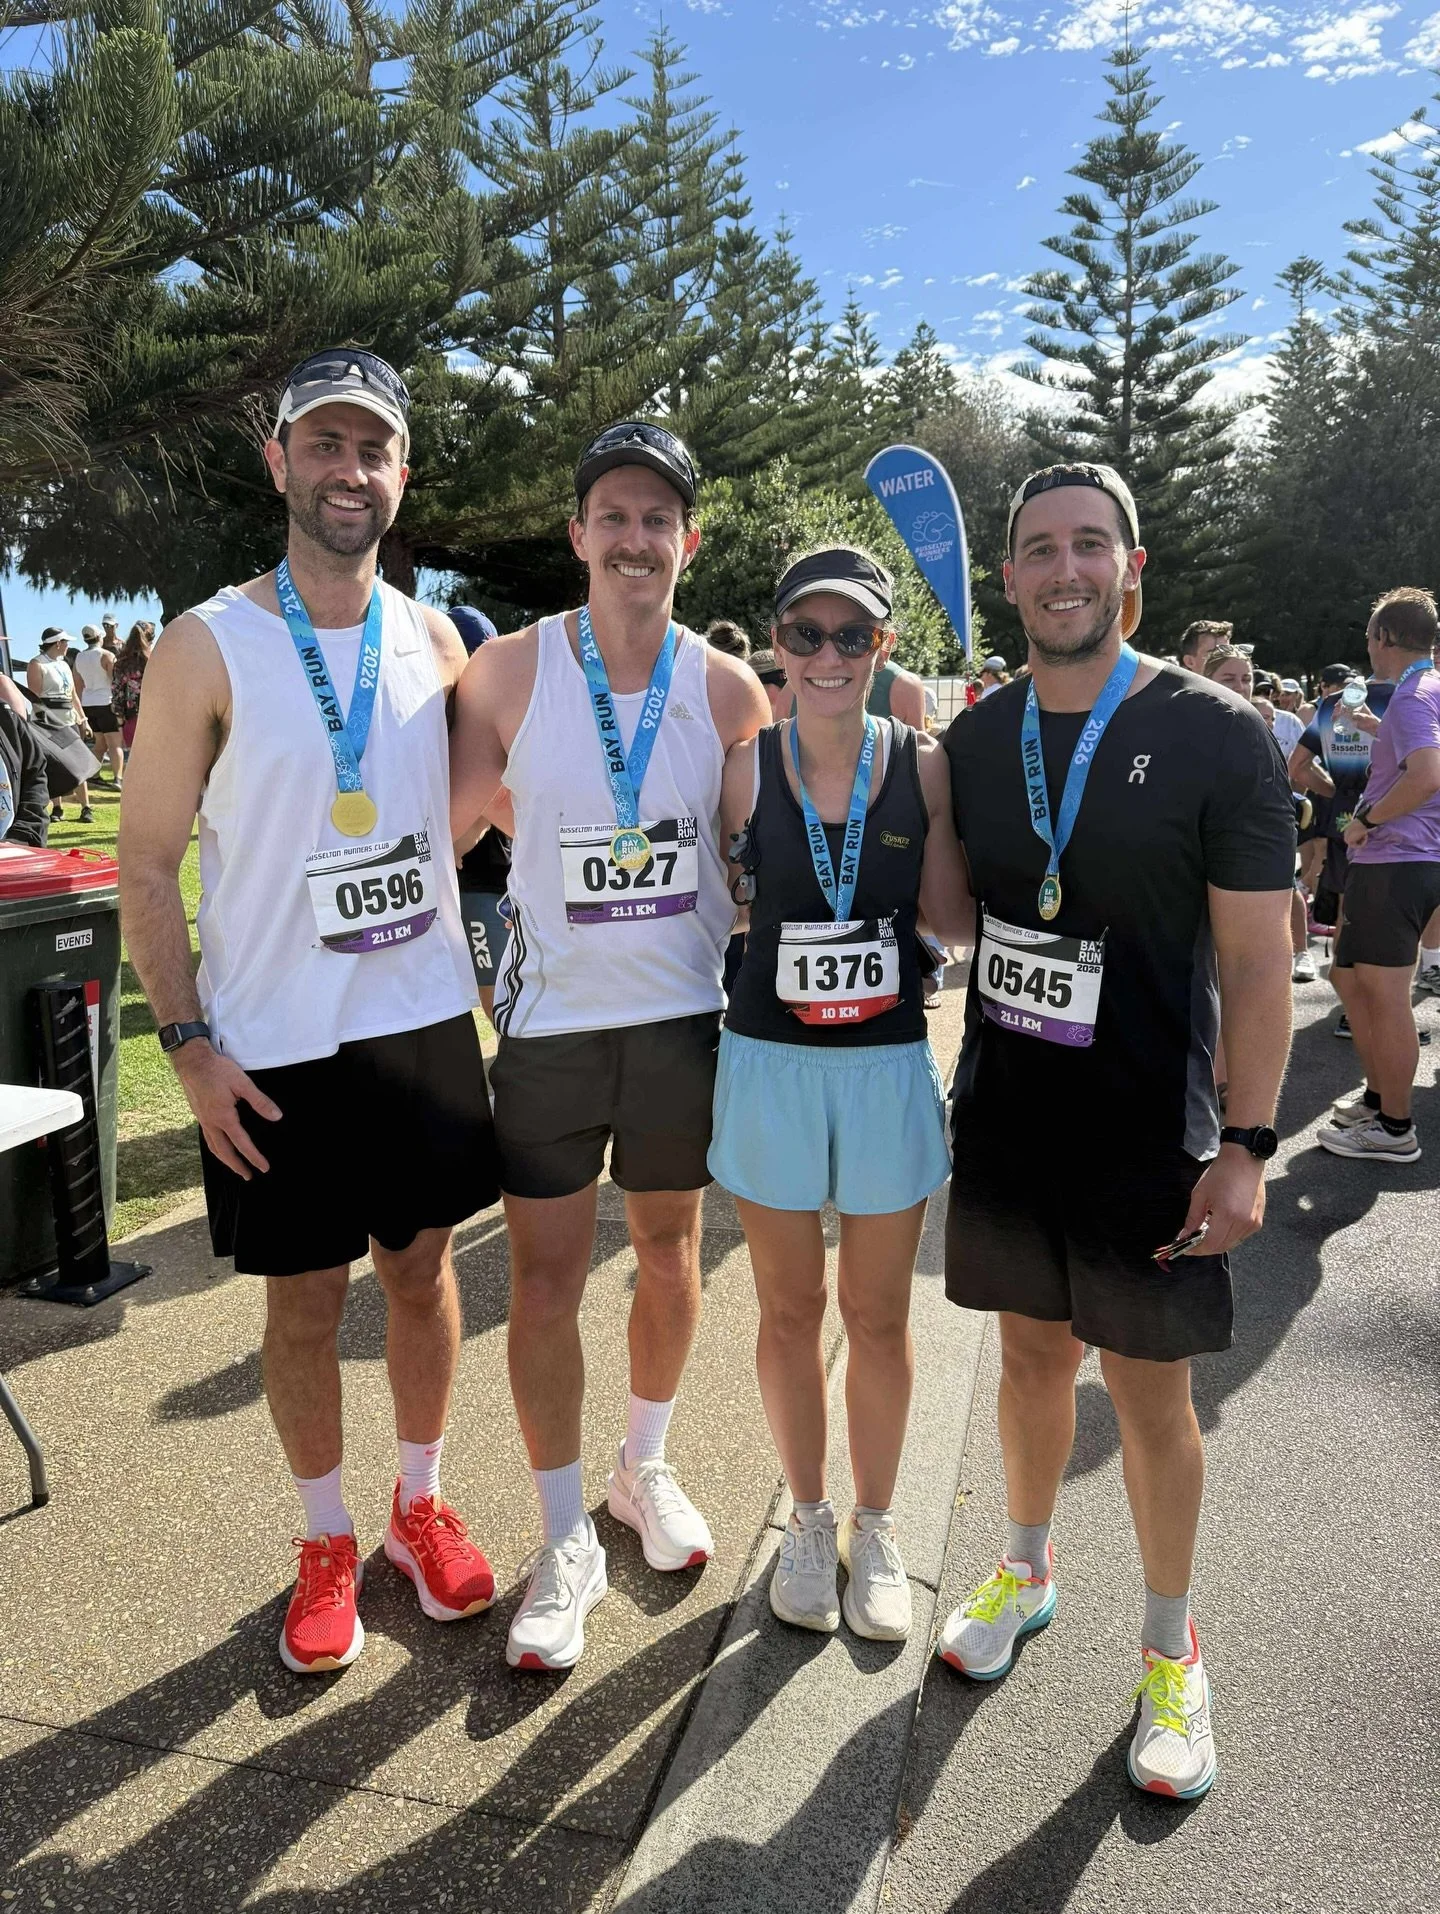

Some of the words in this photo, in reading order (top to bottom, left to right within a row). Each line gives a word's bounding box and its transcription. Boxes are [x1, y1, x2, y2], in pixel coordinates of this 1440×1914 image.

[879, 469, 935, 498] WATER
[301, 646, 329, 688] RUN
[360, 643, 379, 690] 2026
[318, 694, 345, 733] BAY
[594, 692, 616, 732] RUN
[642, 686, 665, 729] 2026
[603, 737, 626, 774] BAY
[861, 727, 876, 767] 10KM
[1074, 718, 1105, 766] 2026
[1023, 737, 1042, 779] RUN
[1032, 784, 1047, 821] BAY
[677, 817, 696, 829] BAY
[677, 828, 696, 839] RUN
[848, 819, 862, 850] RUN
[343, 845, 373, 856] RUNNERS
[374, 842, 390, 851] CLUB
[416, 843, 431, 855] RUN
[621, 839, 639, 847] BAY
[677, 839, 697, 848] 2026
[808, 823, 826, 854] RUN
[582, 851, 678, 892] 0327
[816, 860, 833, 888] BAY
[841, 855, 857, 885] BAY
[335, 868, 424, 920] 0596
[611, 906, 634, 918] 21.1
[636, 903, 657, 916] KM
[877, 918, 893, 928] BAY
[58, 934, 90, 949] EVENTS
[371, 929, 394, 945] 21.1
[394, 924, 412, 939] KM
[470, 921, 494, 969] 2XU
[879, 928, 895, 939] RUN
[880, 940, 897, 948] 2026
[1024, 930, 1040, 940] CLUB
[1076, 964, 1101, 974] 2026
[1078, 951, 1102, 963] RUN
[793, 952, 884, 992] 1376
[988, 953, 1074, 1009] 0545
[821, 1007, 836, 1019] 10
[838, 1006, 860, 1019] KM
[1000, 1010, 1020, 1026] 21.1
[1021, 1016, 1043, 1033] KM
